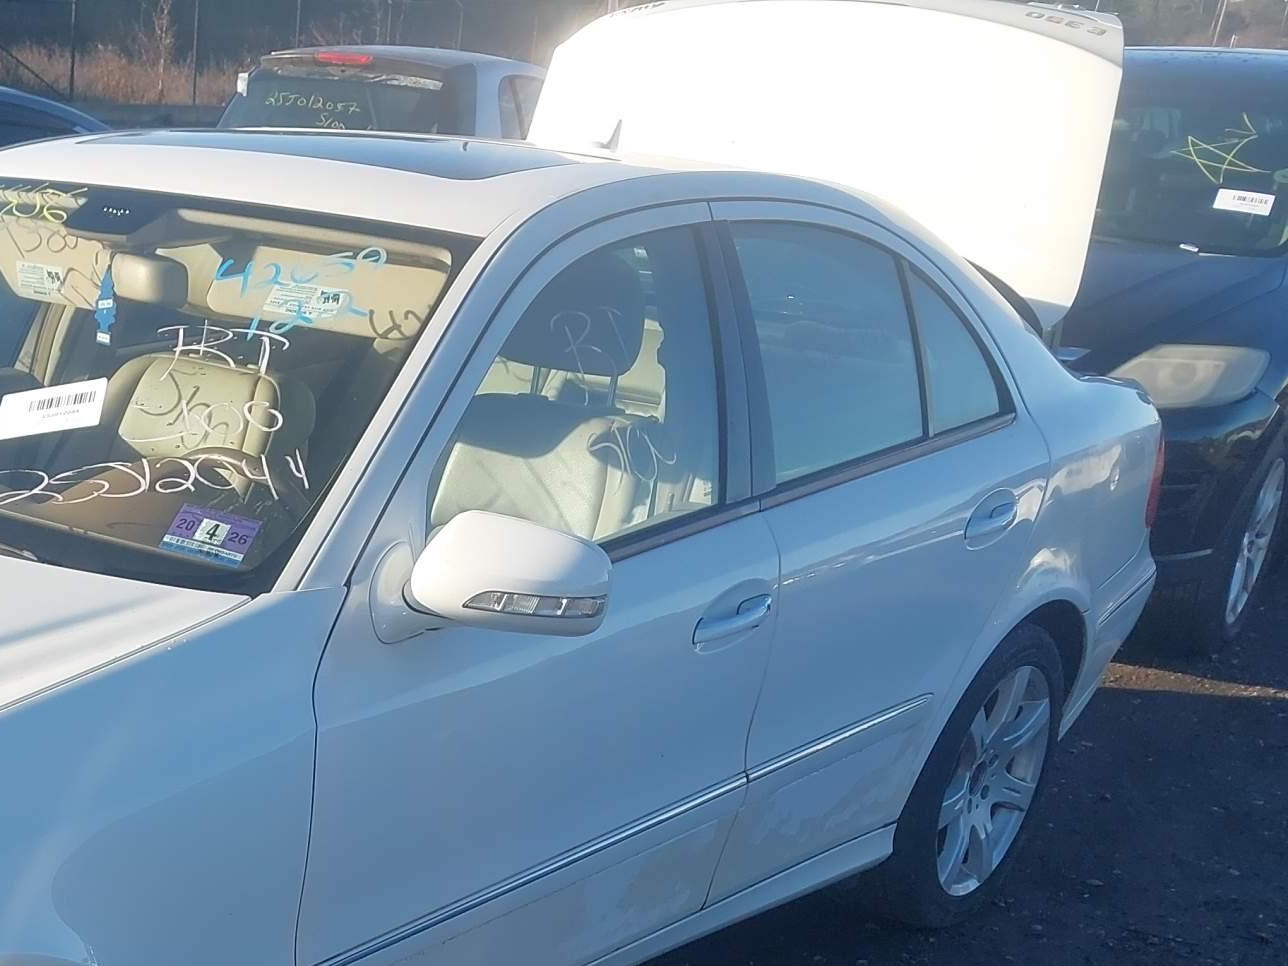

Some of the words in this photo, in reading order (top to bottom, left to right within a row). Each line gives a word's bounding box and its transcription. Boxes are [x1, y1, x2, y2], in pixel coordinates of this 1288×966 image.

[176, 518, 196, 531] 20
[205, 523, 221, 540] 4
[227, 531, 249, 545] 26
